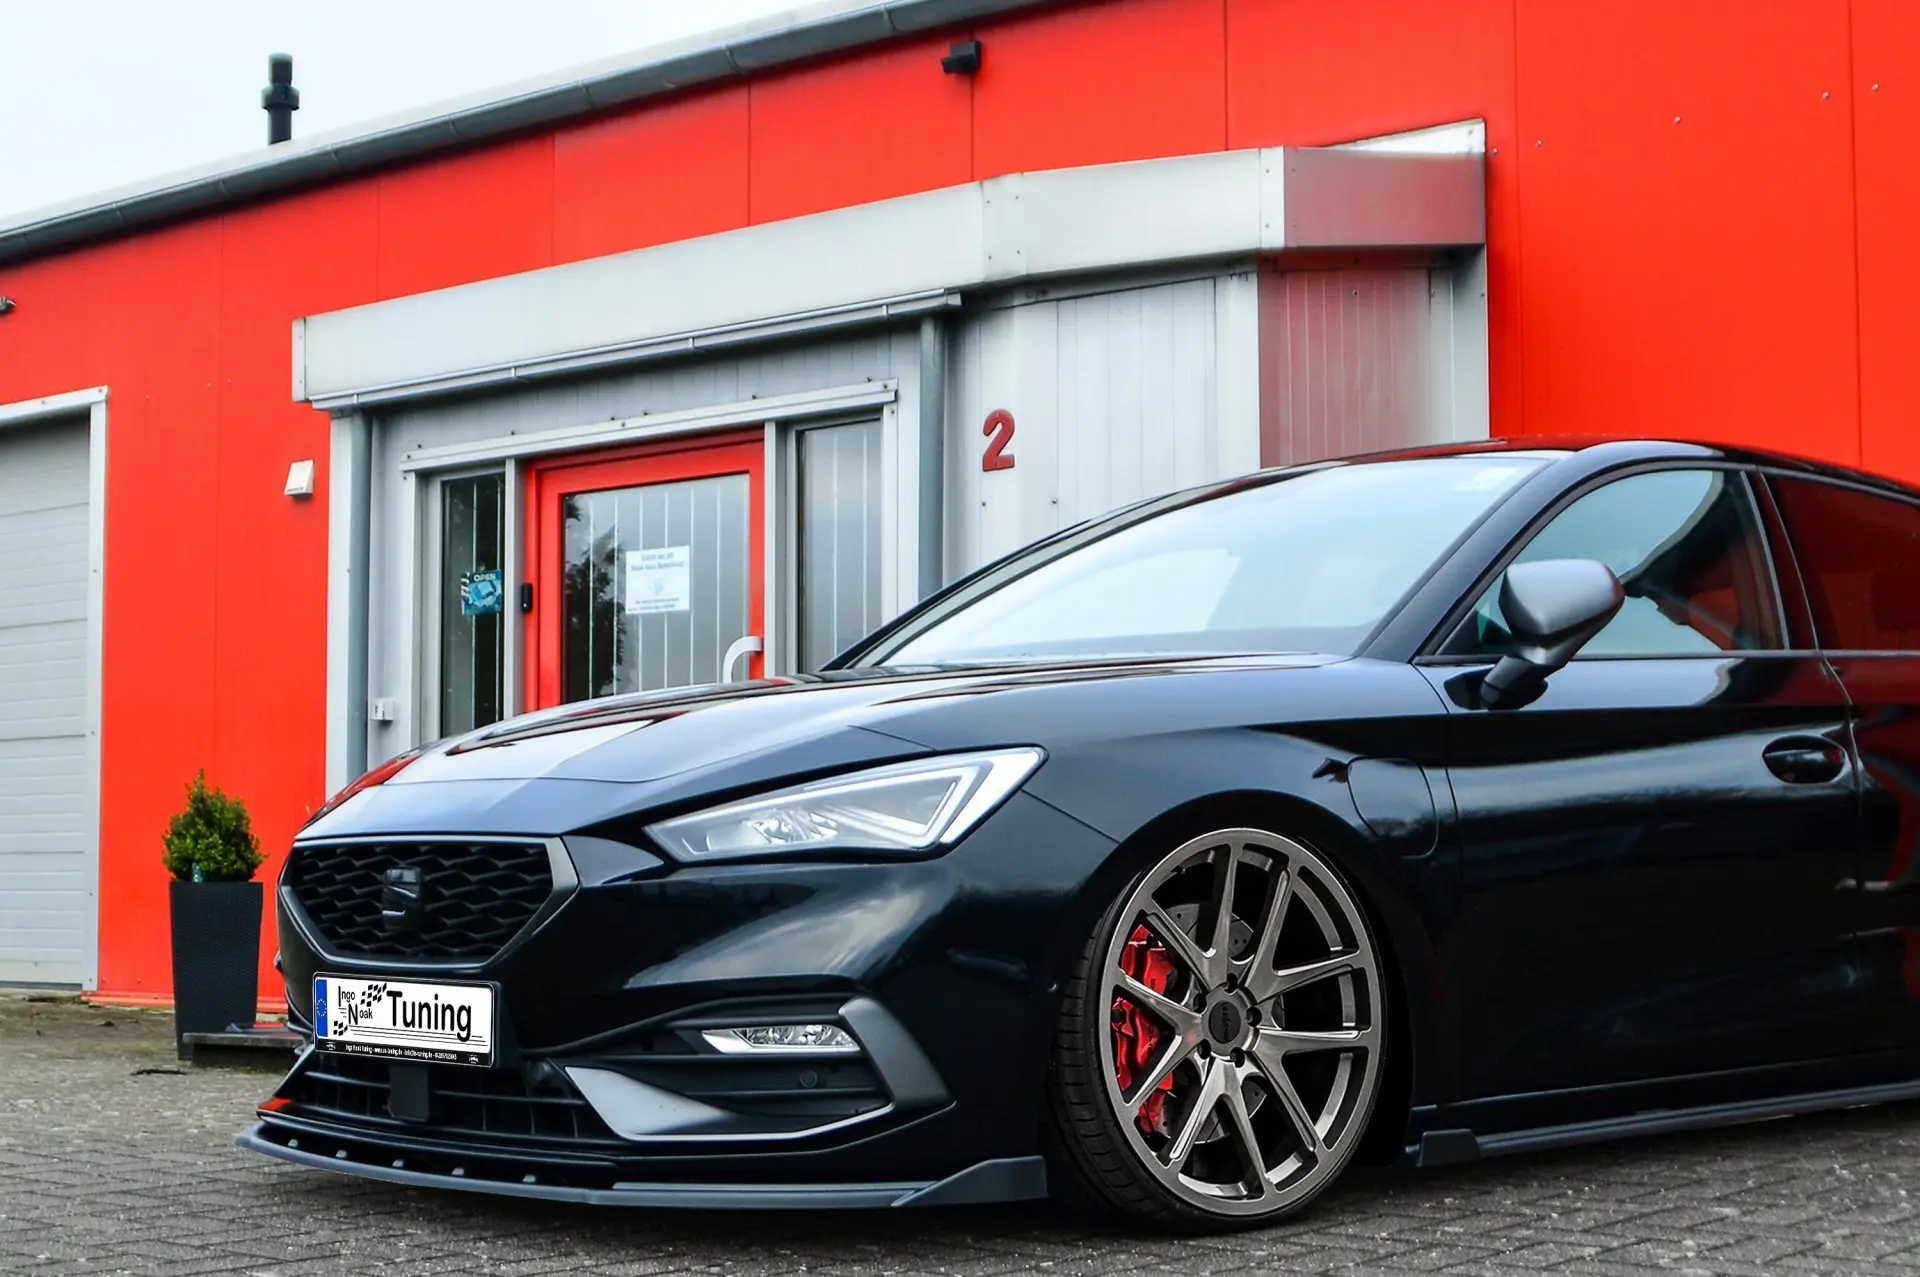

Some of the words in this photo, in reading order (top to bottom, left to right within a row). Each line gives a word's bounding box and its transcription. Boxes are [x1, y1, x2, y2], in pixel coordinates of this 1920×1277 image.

[983, 408, 1015, 472] 2
[473, 573, 496, 582] OPEN
[338, 985, 356, 1007] Ingo
[348, 1003, 373, 1025] Noak
[386, 990, 472, 1042] Tuning
